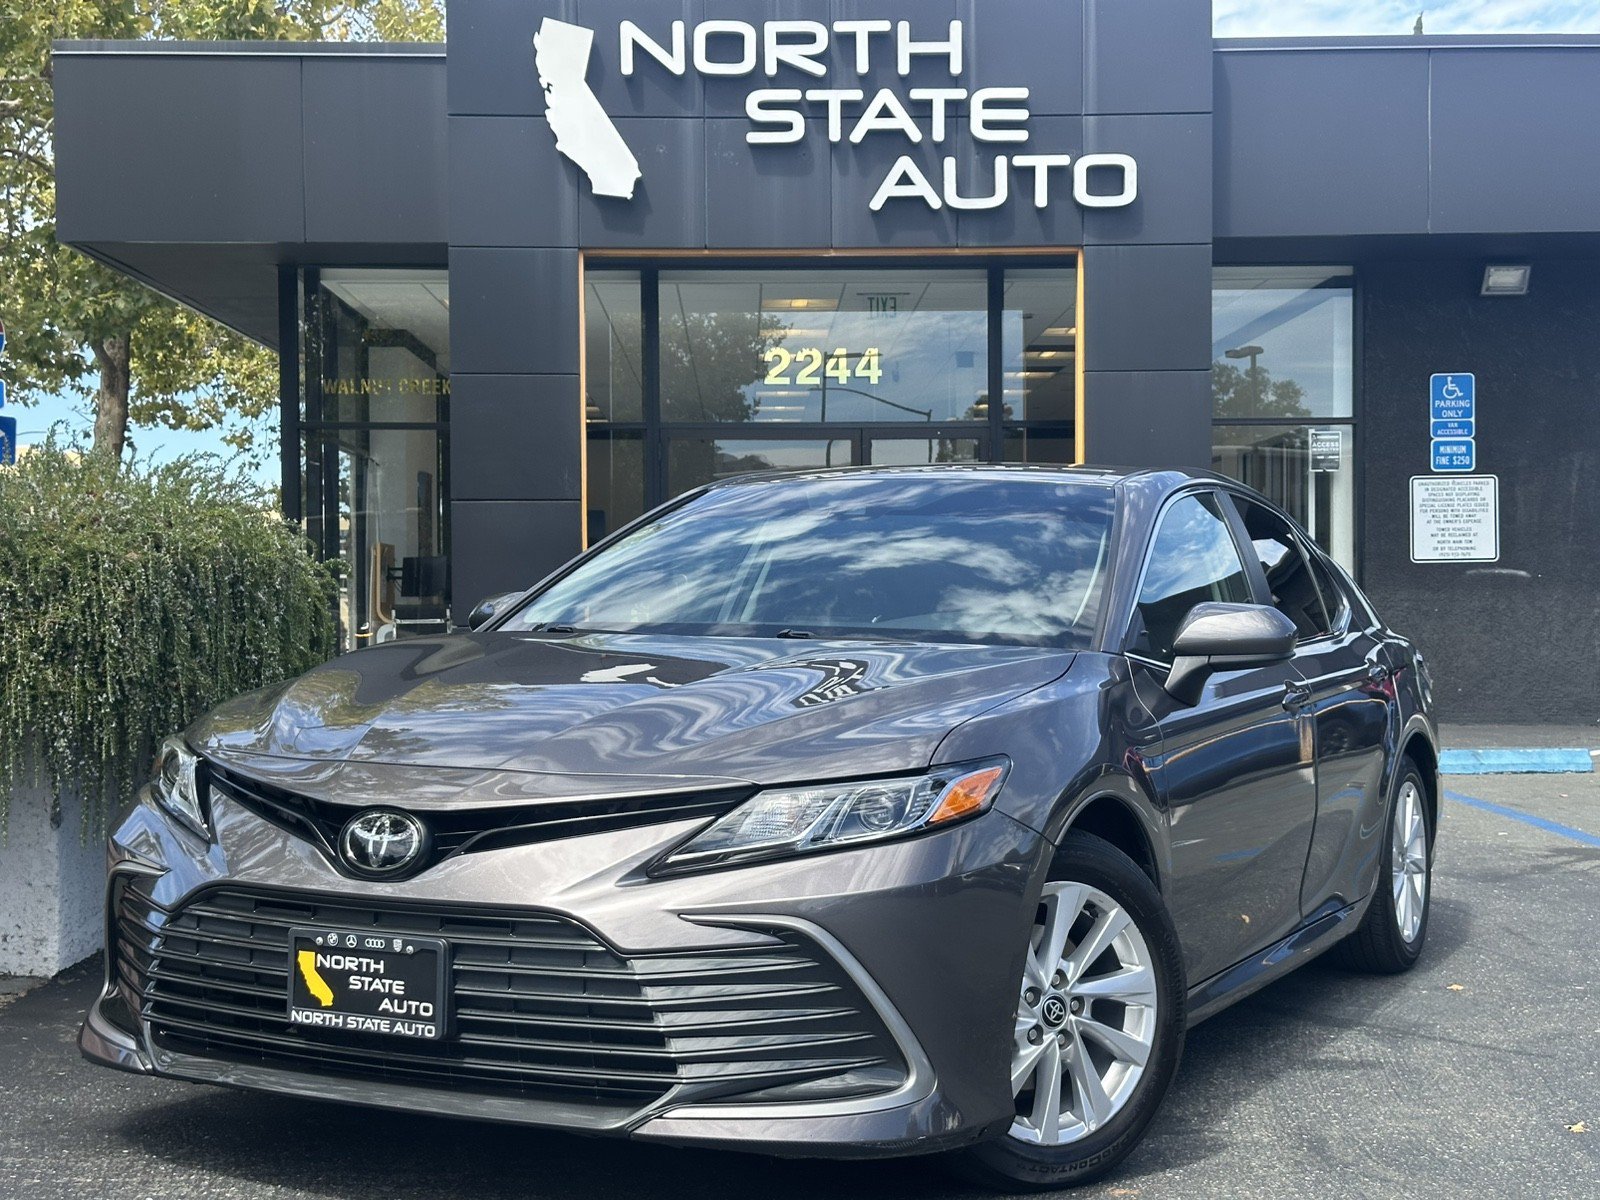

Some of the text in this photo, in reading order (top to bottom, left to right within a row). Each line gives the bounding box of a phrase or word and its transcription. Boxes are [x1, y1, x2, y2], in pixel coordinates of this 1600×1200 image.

[619, 20, 963, 77] NORTH
[745, 86, 1030, 144] STATE
[869, 154, 1138, 211] AUTO
[763, 346, 883, 385] 2244
[1435, 400, 1470, 408] PARKING
[1442, 410, 1463, 418] ONLY
[1439, 445, 1466, 454] MINIMUM
[1436, 456, 1470, 465] FINE $250
[316, 953, 385, 974] NORTH
[349, 975, 405, 995] STATE
[378, 998, 433, 1017] AUTO
[291, 1009, 436, 1038] NORTH STATE AUTO
